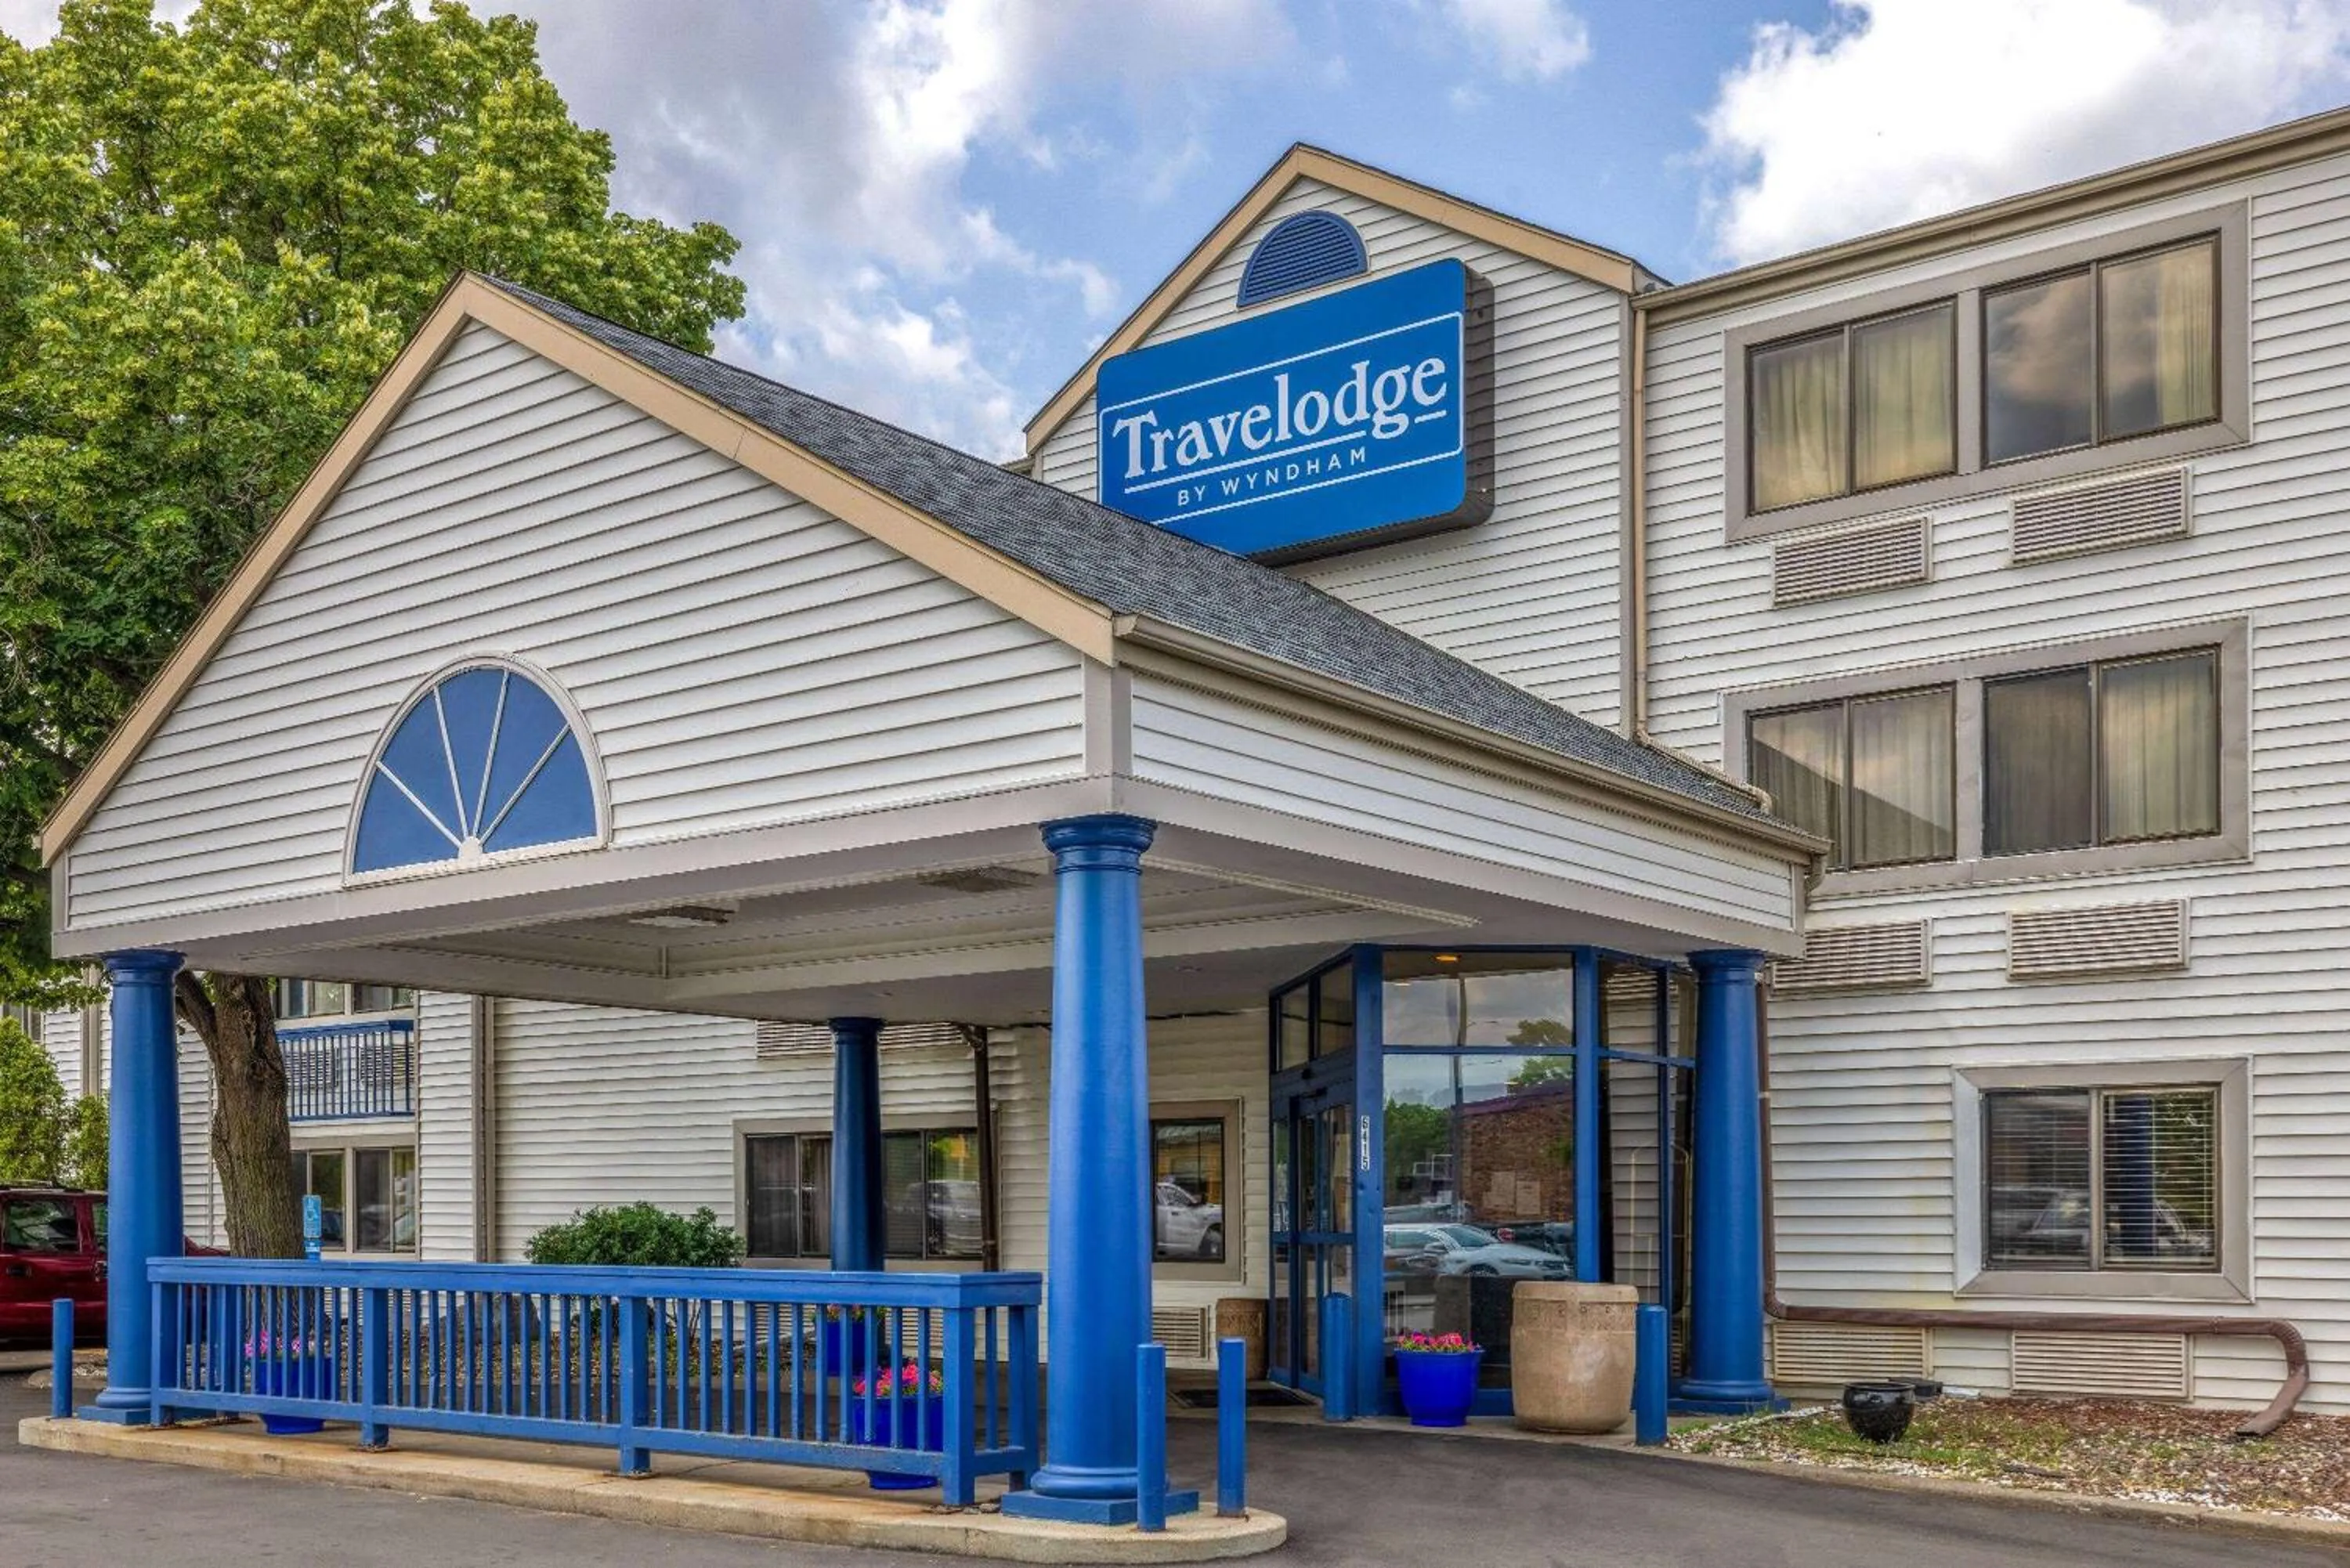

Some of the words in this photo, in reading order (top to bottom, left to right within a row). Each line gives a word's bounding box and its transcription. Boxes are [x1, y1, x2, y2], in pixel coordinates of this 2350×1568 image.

[1112, 357, 1447, 479] Travelodge
[1177, 485, 1206, 506] BY
[1220, 447, 1366, 496] WYNDHAM
